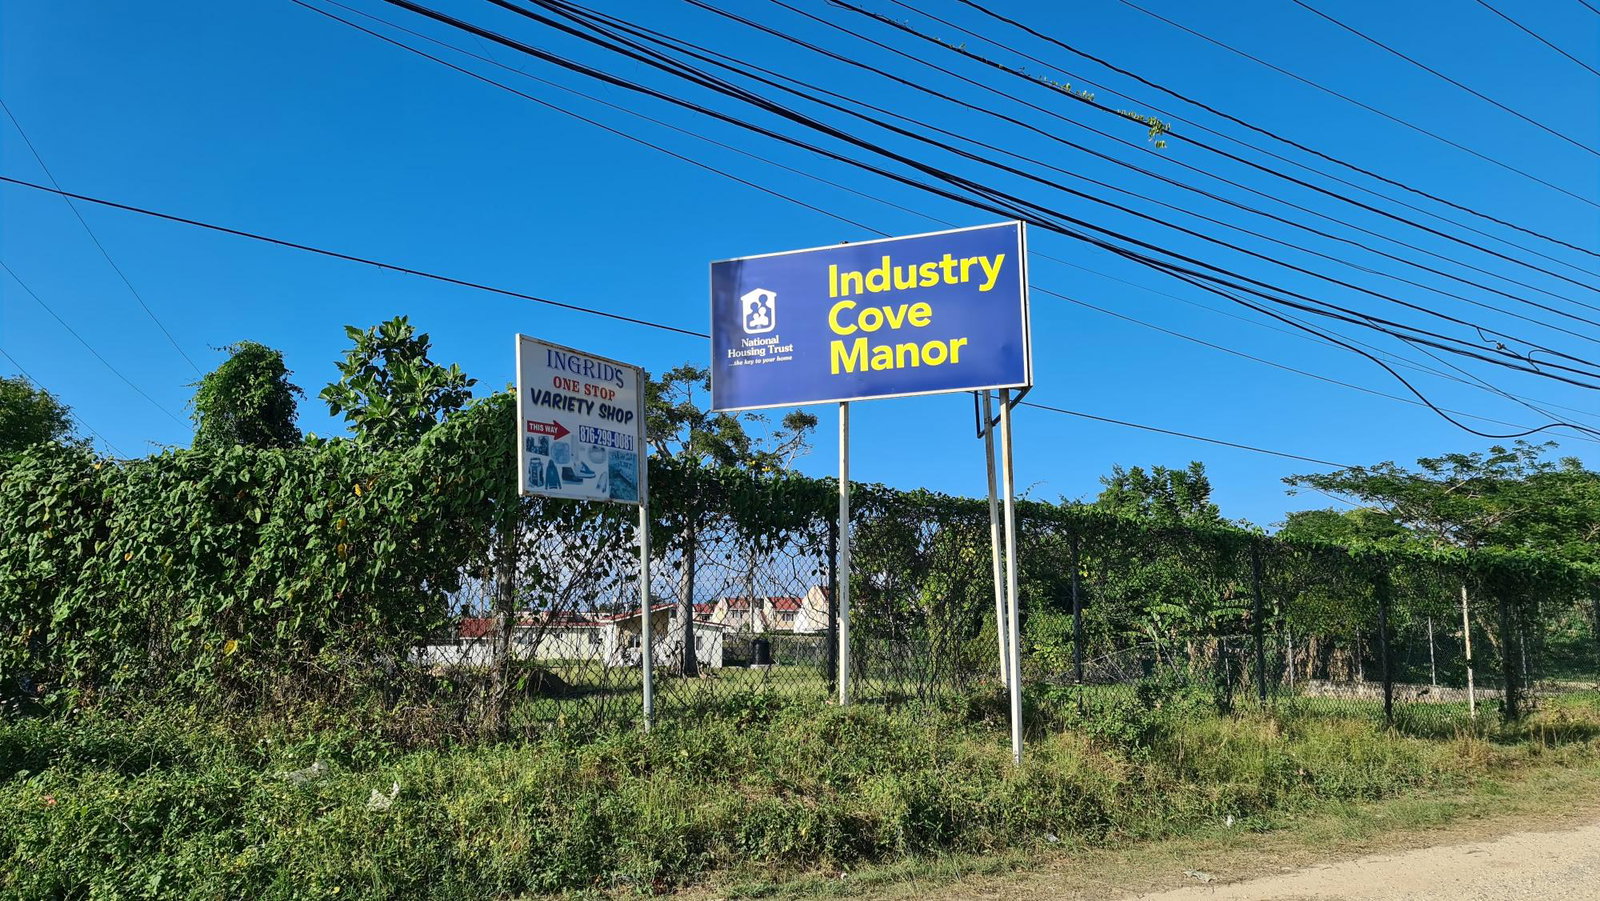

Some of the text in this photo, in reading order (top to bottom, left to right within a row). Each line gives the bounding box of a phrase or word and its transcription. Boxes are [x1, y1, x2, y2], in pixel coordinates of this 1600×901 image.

[828, 253, 1005, 298] Industry
[828, 300, 932, 335] Cove
[728, 344, 794, 358] Housing Trust
[741, 335, 779, 347] National
[830, 337, 967, 375] Manor
[547, 349, 624, 389] INGRID'S
[553, 376, 616, 401] ONE STOP
[530, 387, 634, 424] VARIETY SHOP
[528, 422, 559, 433] THIS WAY
[580, 426, 633, 451] 876-299-0081
